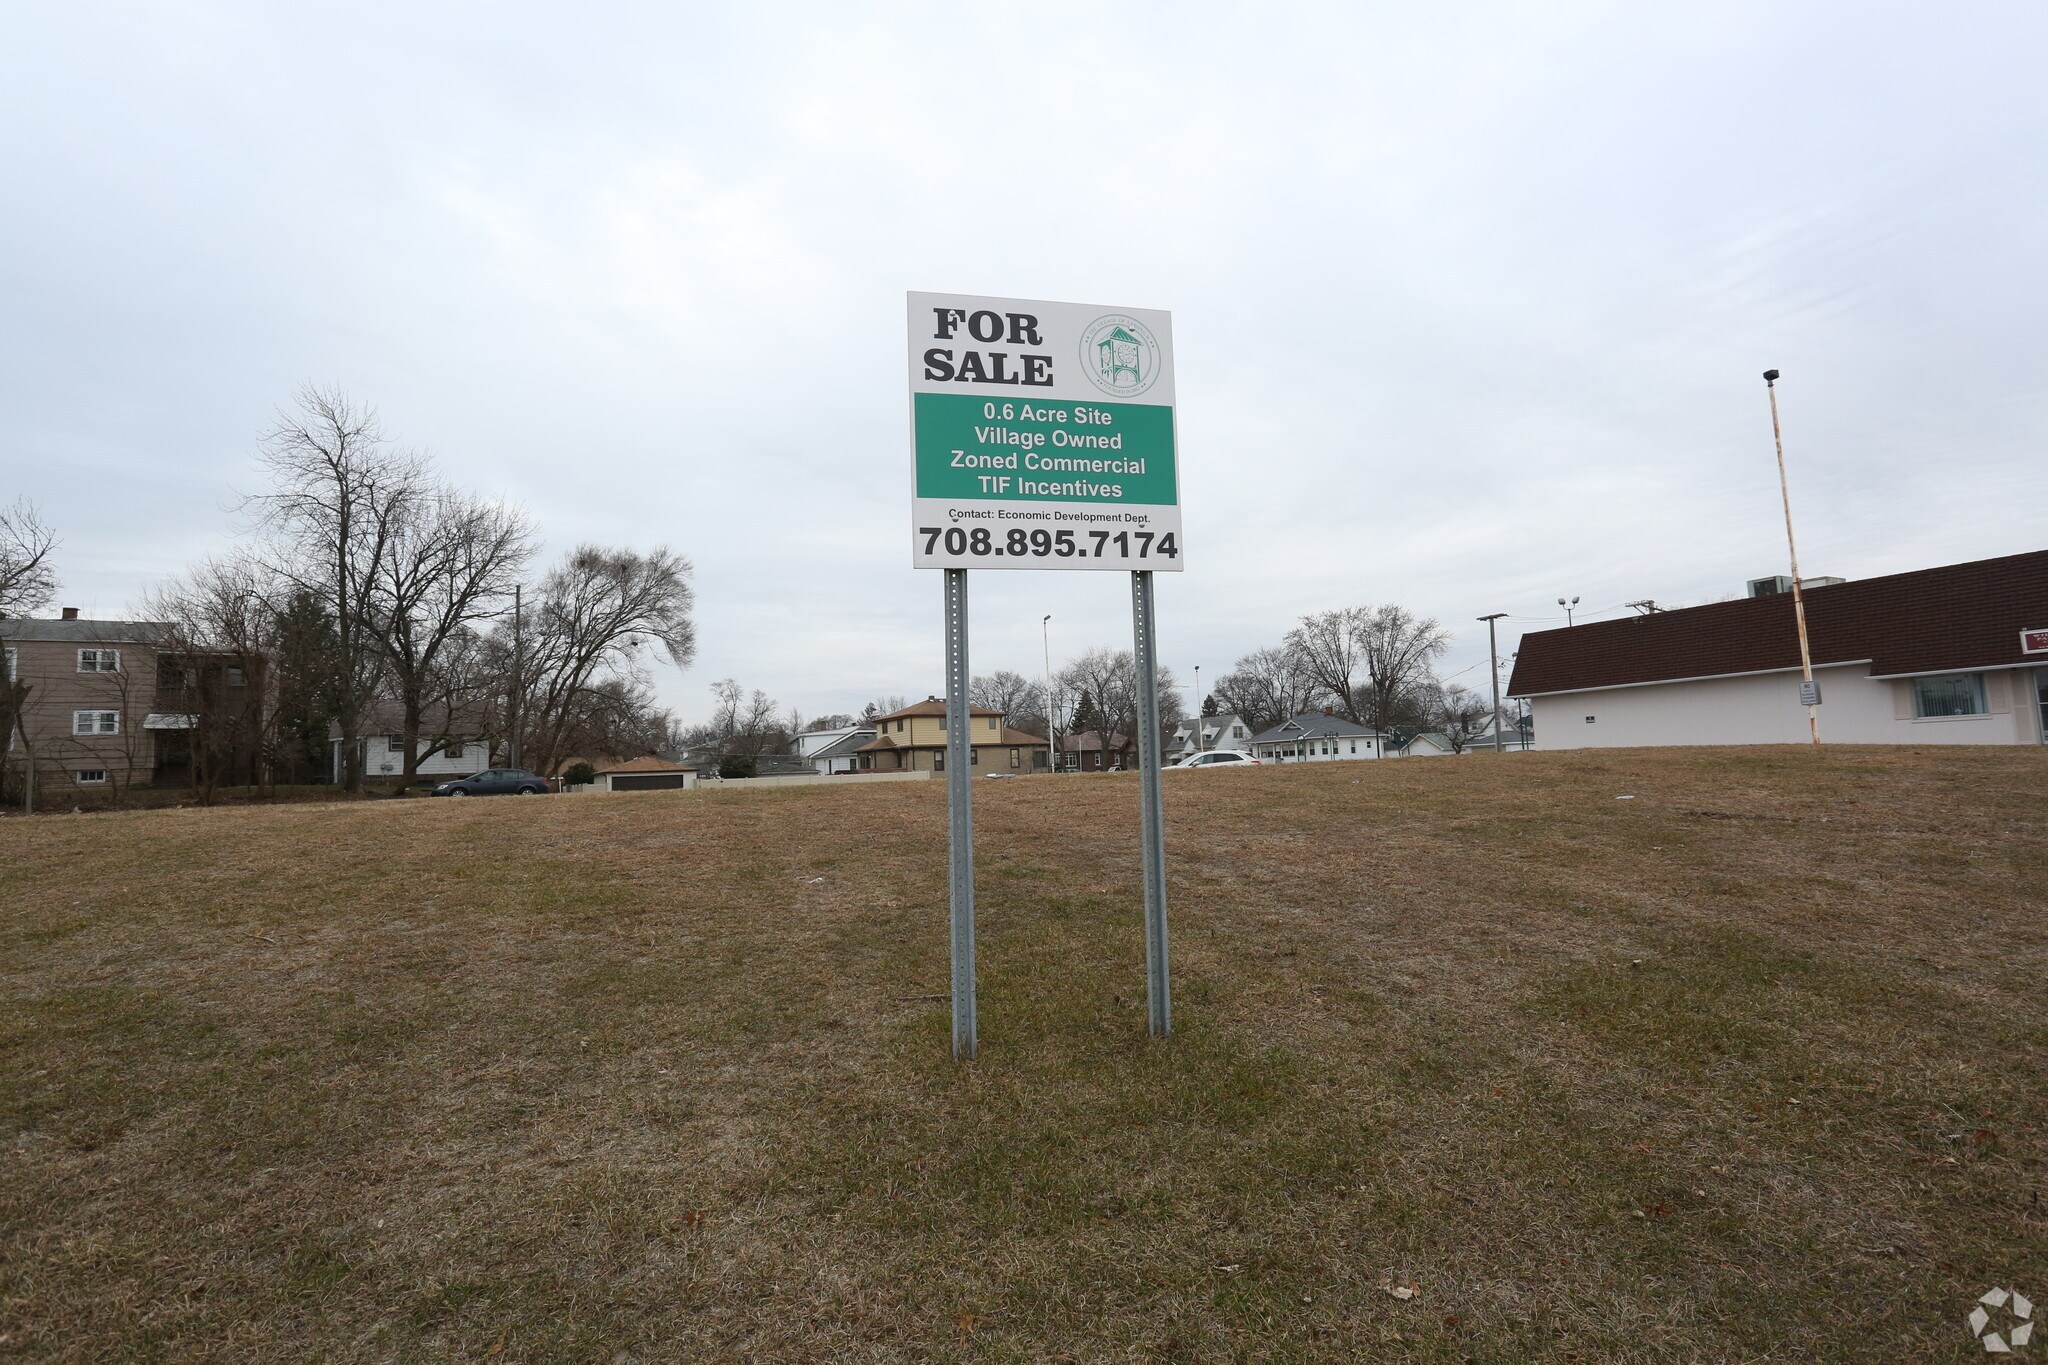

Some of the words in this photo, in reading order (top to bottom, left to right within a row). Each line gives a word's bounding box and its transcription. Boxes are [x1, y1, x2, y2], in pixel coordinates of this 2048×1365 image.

[933, 307, 1043, 346] FOR
[923, 348, 1054, 387] SALE
[983, 402, 1014, 421] 0.6
[1020, 404, 1068, 423] Acre
[1074, 406, 1113, 425] Site
[974, 426, 1046, 449] Village
[1052, 429, 1122, 450] Owned
[950, 450, 1018, 470] Zoned
[1024, 452, 1146, 475] Commercial
[977, 475, 1011, 494] TIF
[1018, 477, 1123, 497] Incentives
[948, 508, 995, 520] Contact:
[998, 509, 1051, 520] Economic
[1054, 511, 1122, 523] Development
[1124, 513, 1151, 525] Dept.
[919, 526, 1178, 559] 708.895.7174
